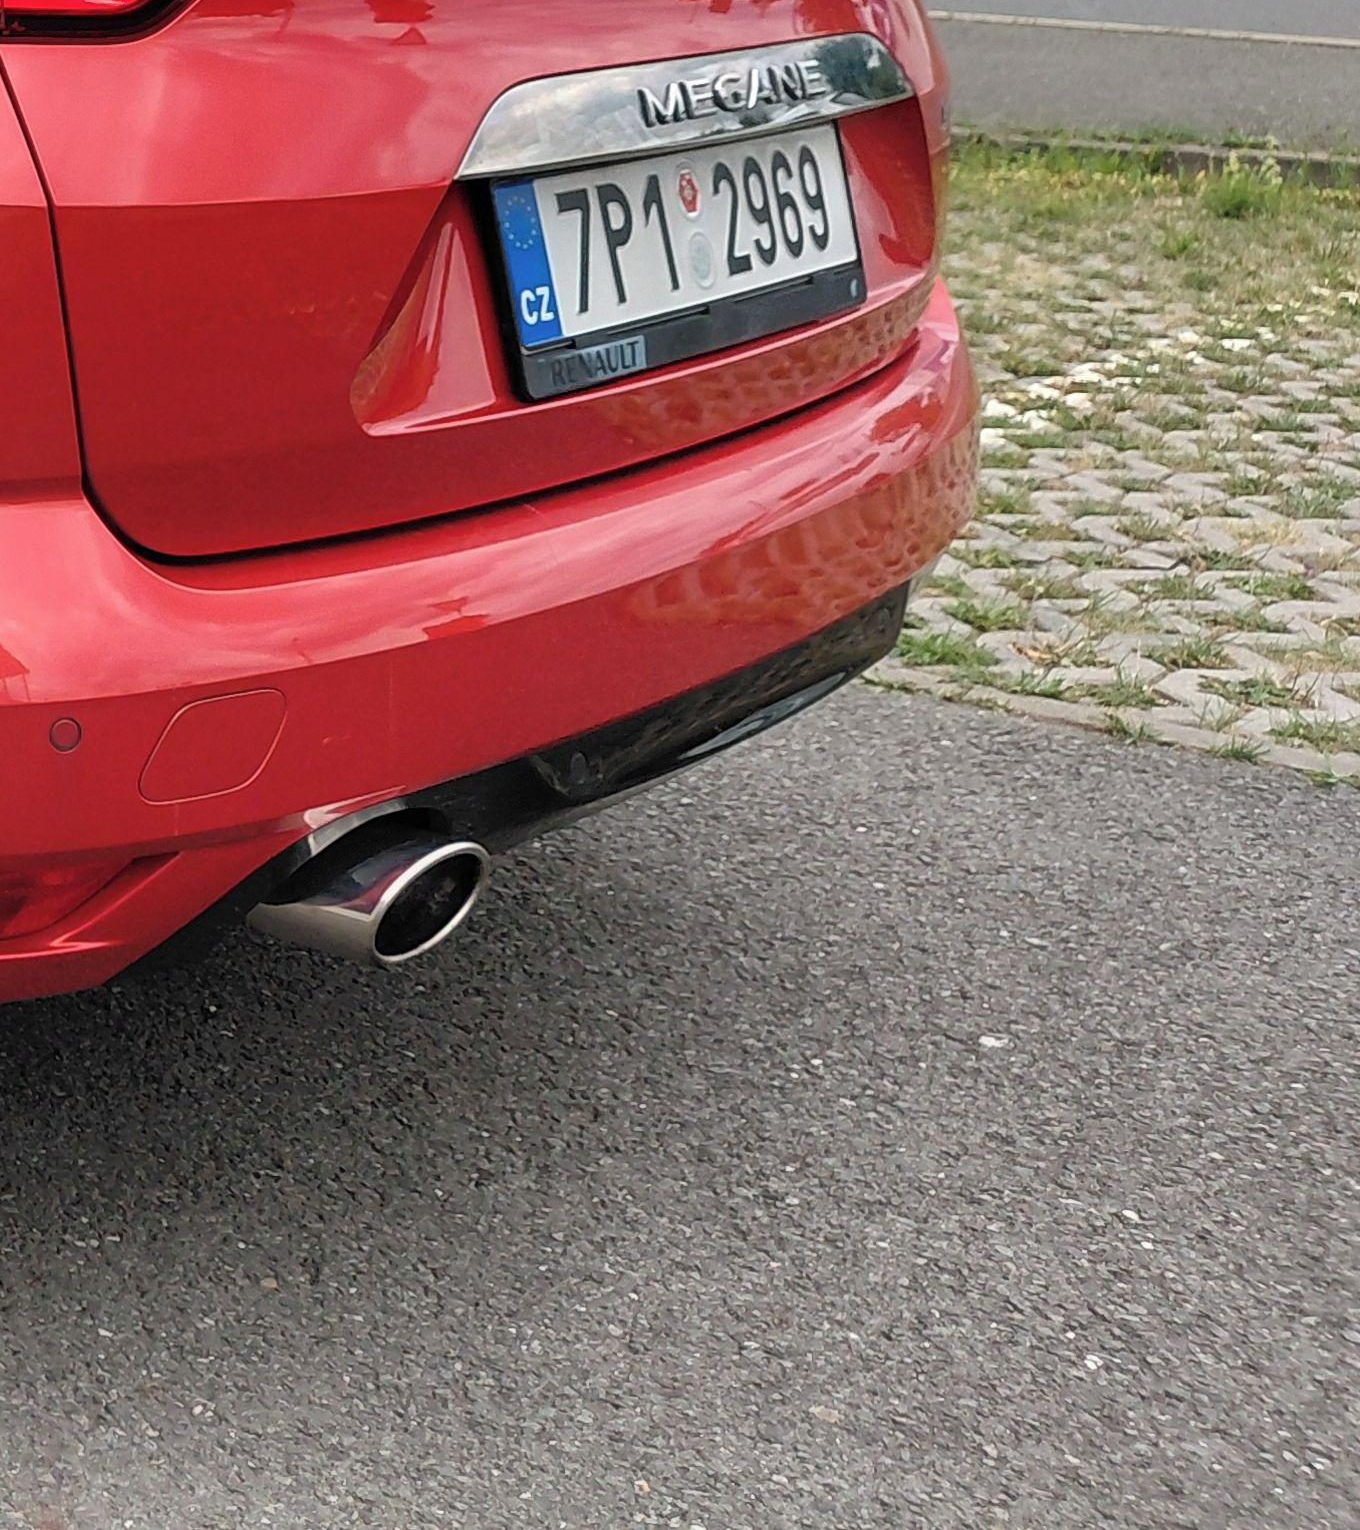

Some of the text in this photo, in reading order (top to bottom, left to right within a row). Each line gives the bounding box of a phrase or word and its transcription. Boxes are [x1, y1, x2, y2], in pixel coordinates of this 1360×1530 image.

[636, 59, 828, 129] MEGANE
[555, 144, 831, 316] 7P1 2969
[520, 284, 556, 327] CZ
[551, 339, 640, 388] RENAULT
